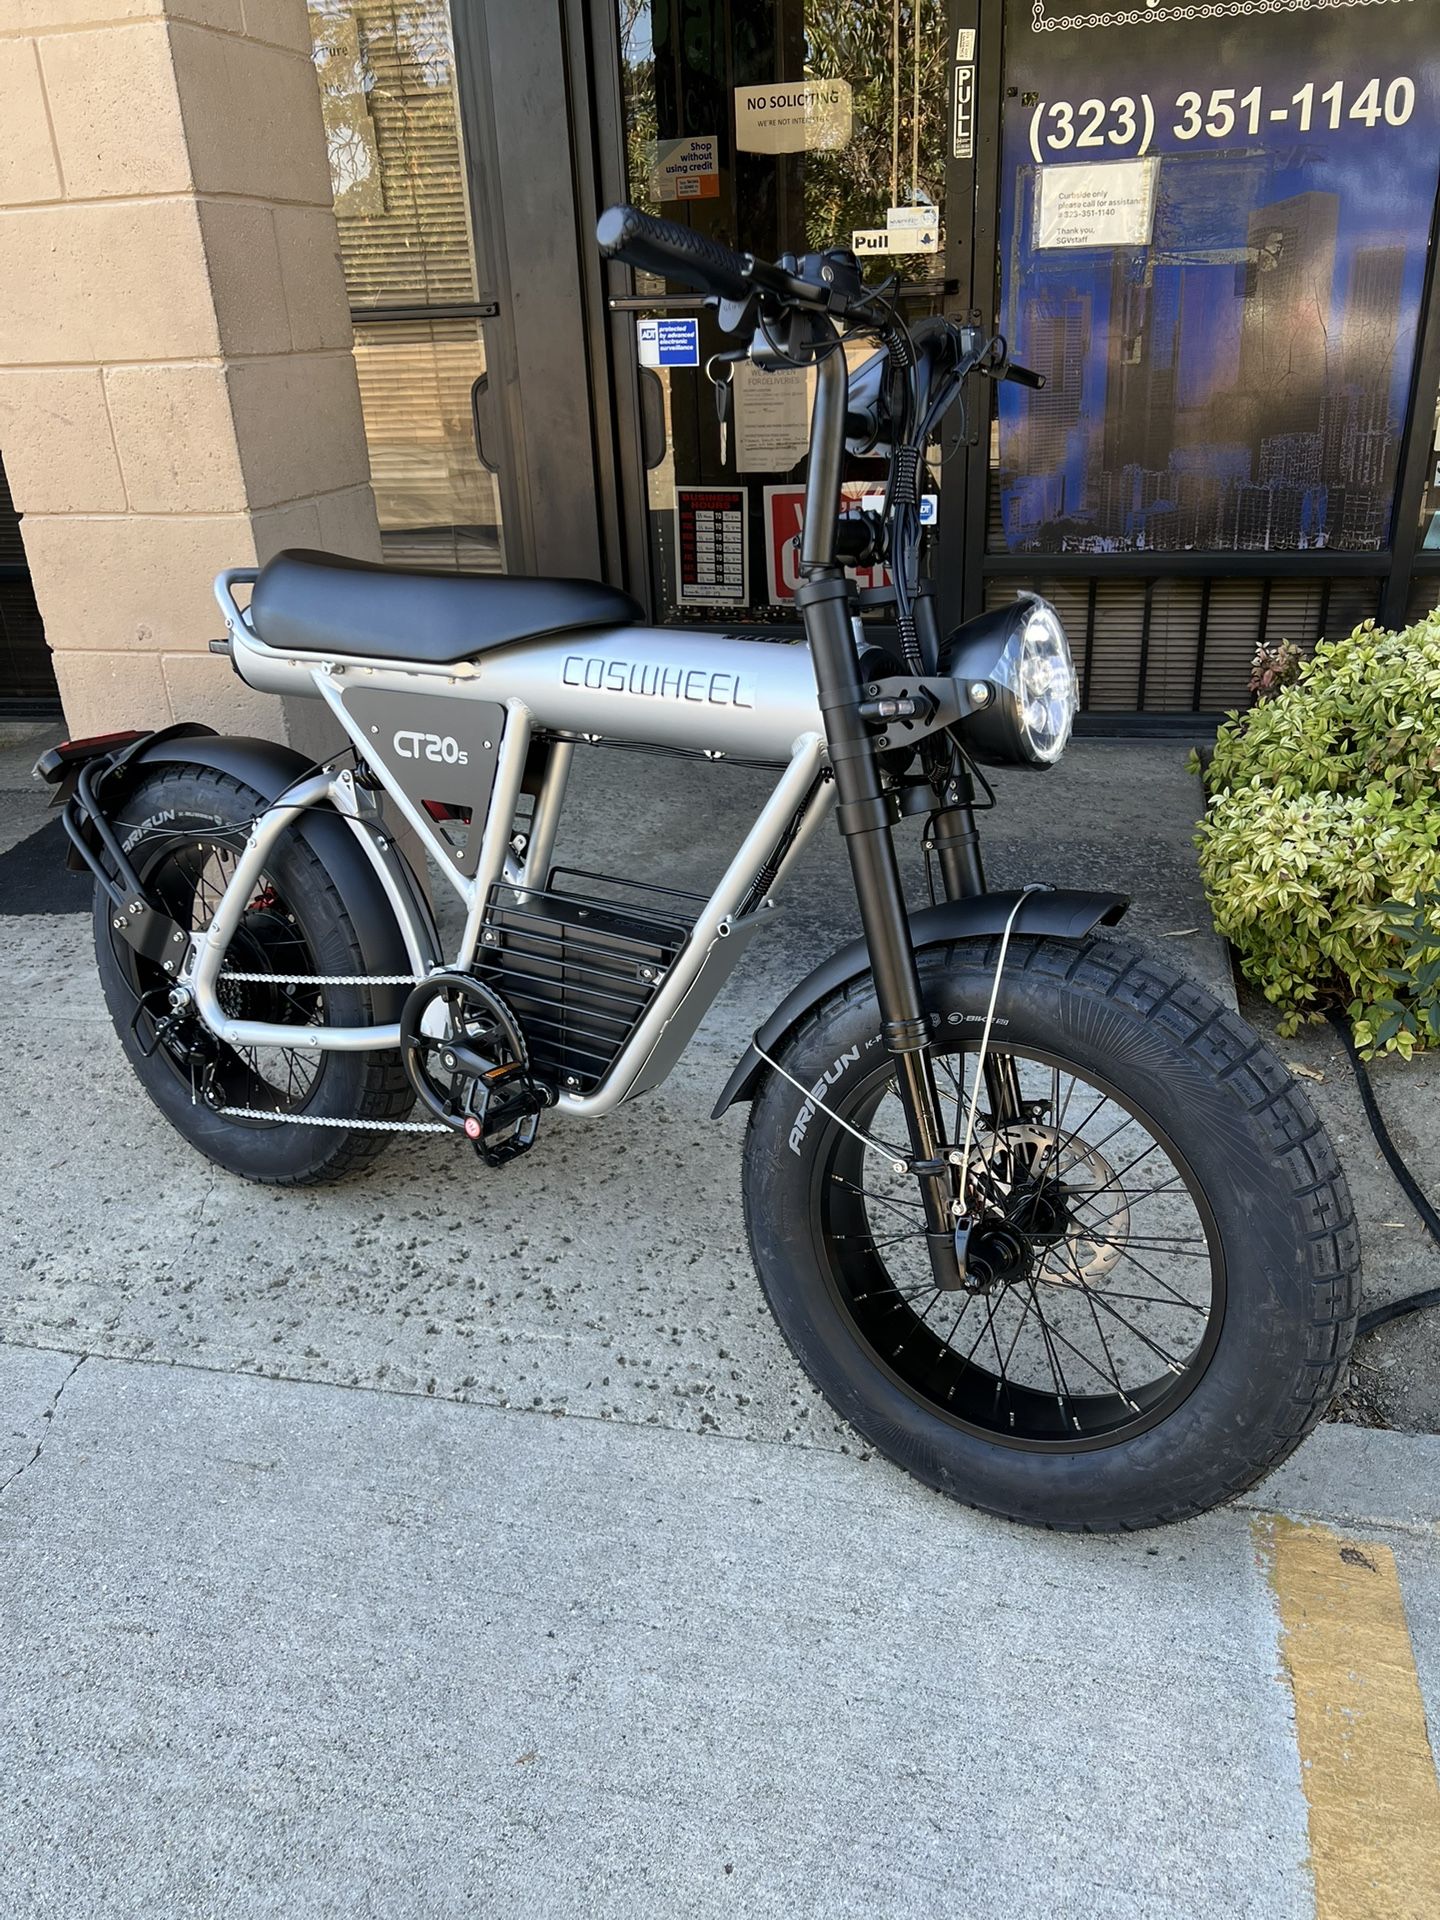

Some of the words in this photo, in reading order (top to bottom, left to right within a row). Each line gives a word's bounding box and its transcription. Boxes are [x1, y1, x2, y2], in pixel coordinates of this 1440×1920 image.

[747, 97, 767, 110] NO
[957, 68, 972, 137] PULL
[777, 118, 791, 126] NOT
[1029, 94, 1155, 163] (323)
[1172, 76, 1415, 140] 351-1140
[690, 142, 712, 151] Shop
[680, 152, 712, 162] without
[665, 164, 688, 173] using
[689, 161, 713, 171] credit
[1058, 191, 1092, 200] Curbside
[1092, 190, 1109, 199] only
[1058, 201, 1082, 210] please
[1082, 200, 1096, 208] call
[1096, 199, 1108, 208] for
[1056, 228, 1079, 236] Thank
[854, 235, 889, 249] Pull
[641, 329, 656, 339] ADT
[659, 325, 687, 333] protected
[562, 655, 753, 709] COSWHEEL
[788, 1044, 861, 1157] ARISUN
